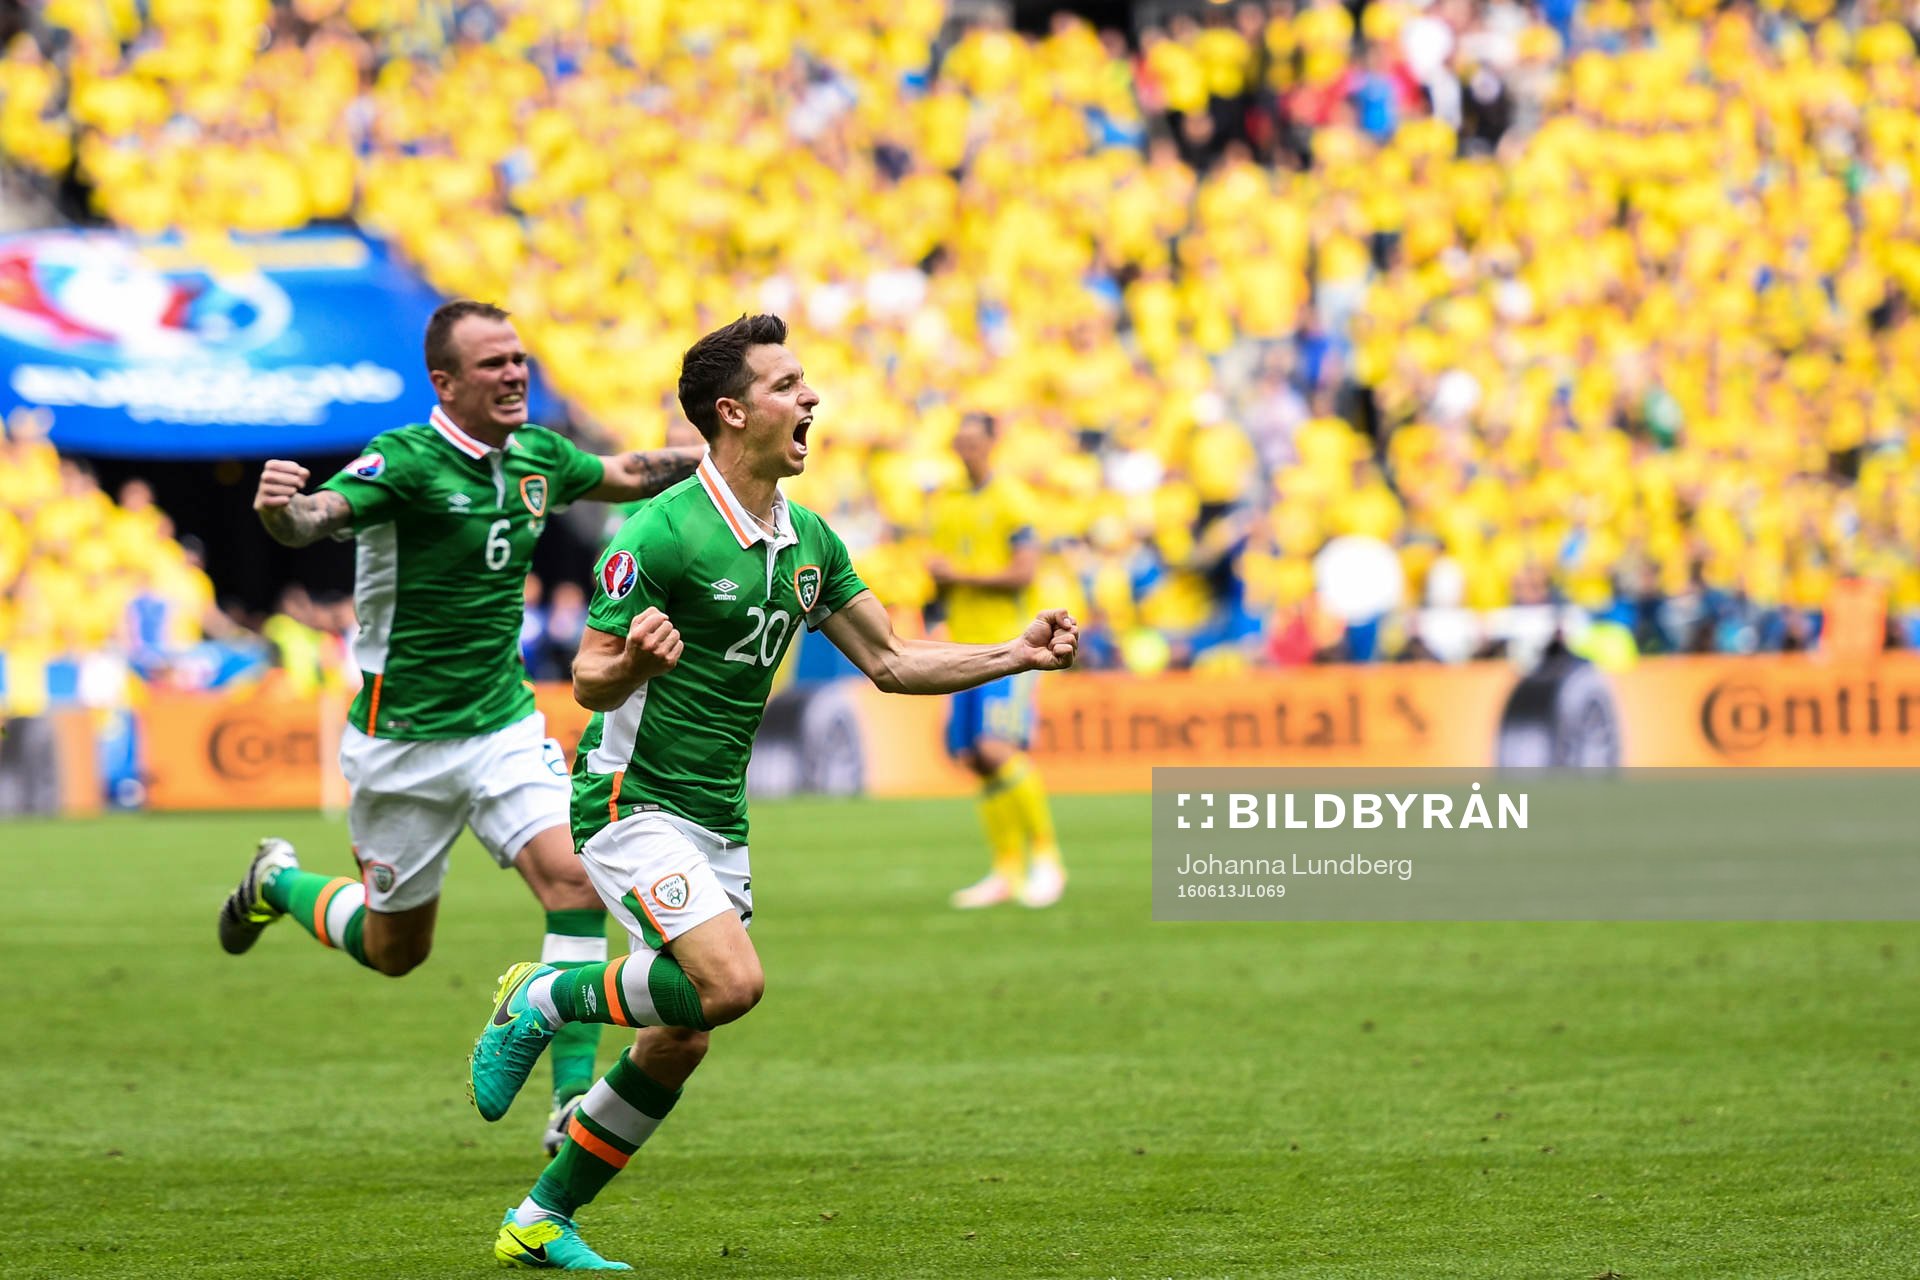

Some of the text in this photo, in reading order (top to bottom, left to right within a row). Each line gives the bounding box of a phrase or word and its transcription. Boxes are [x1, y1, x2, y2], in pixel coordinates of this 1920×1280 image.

[485, 518, 511, 571] 6
[713, 592, 737, 601] umbro
[724, 606, 790, 667] 20
[1037, 694, 1362, 752] ntinental
